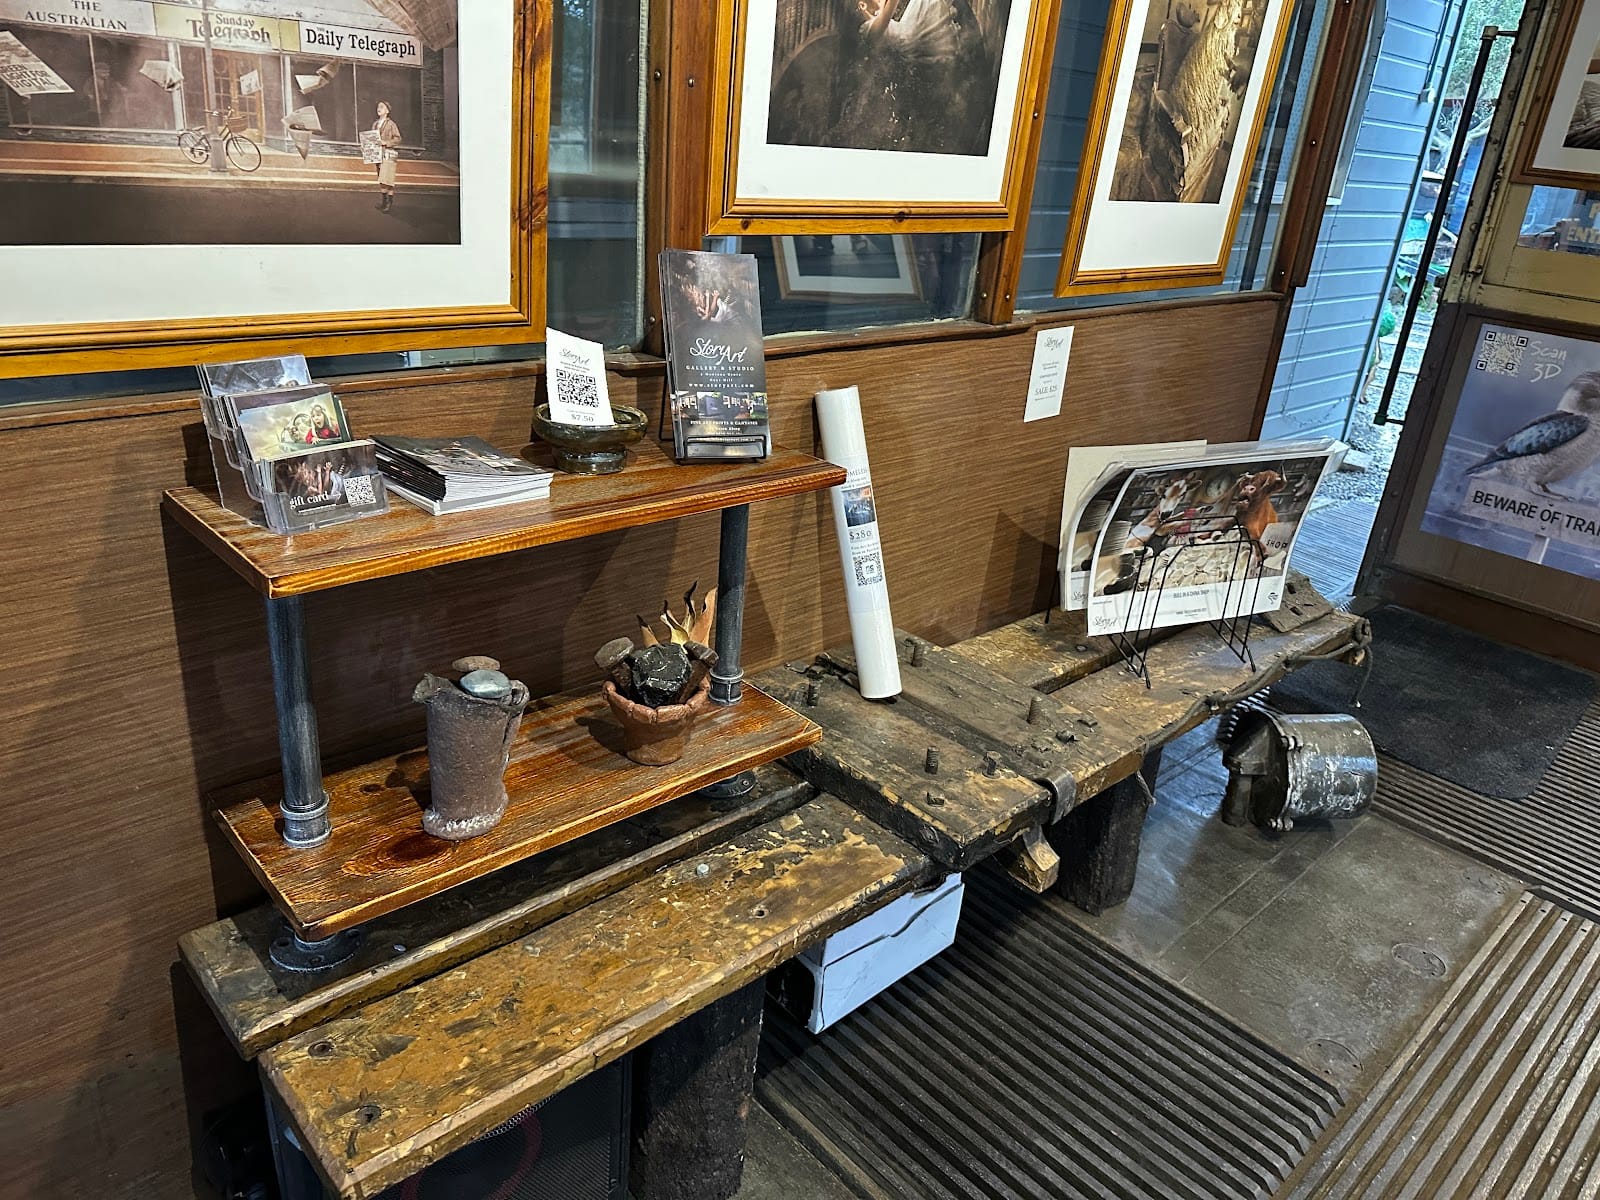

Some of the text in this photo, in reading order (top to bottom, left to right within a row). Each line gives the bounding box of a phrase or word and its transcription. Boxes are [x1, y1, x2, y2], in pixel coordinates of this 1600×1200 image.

[72, 0, 101, 11] THE
[25, 11, 127, 30] AUSTRALIAN
[215, 14, 255, 29] Sunday
[306, 29, 416, 57] Daily Telegraph
[1530, 340, 1567, 360] Scan
[1530, 363, 1562, 383] 3D
[290, 490, 330, 510] gift card
[1472, 490, 1600, 537] BEWARE OF TRA
[849, 529, 872, 540] $280
[1266, 539, 1288, 549] SHOP
